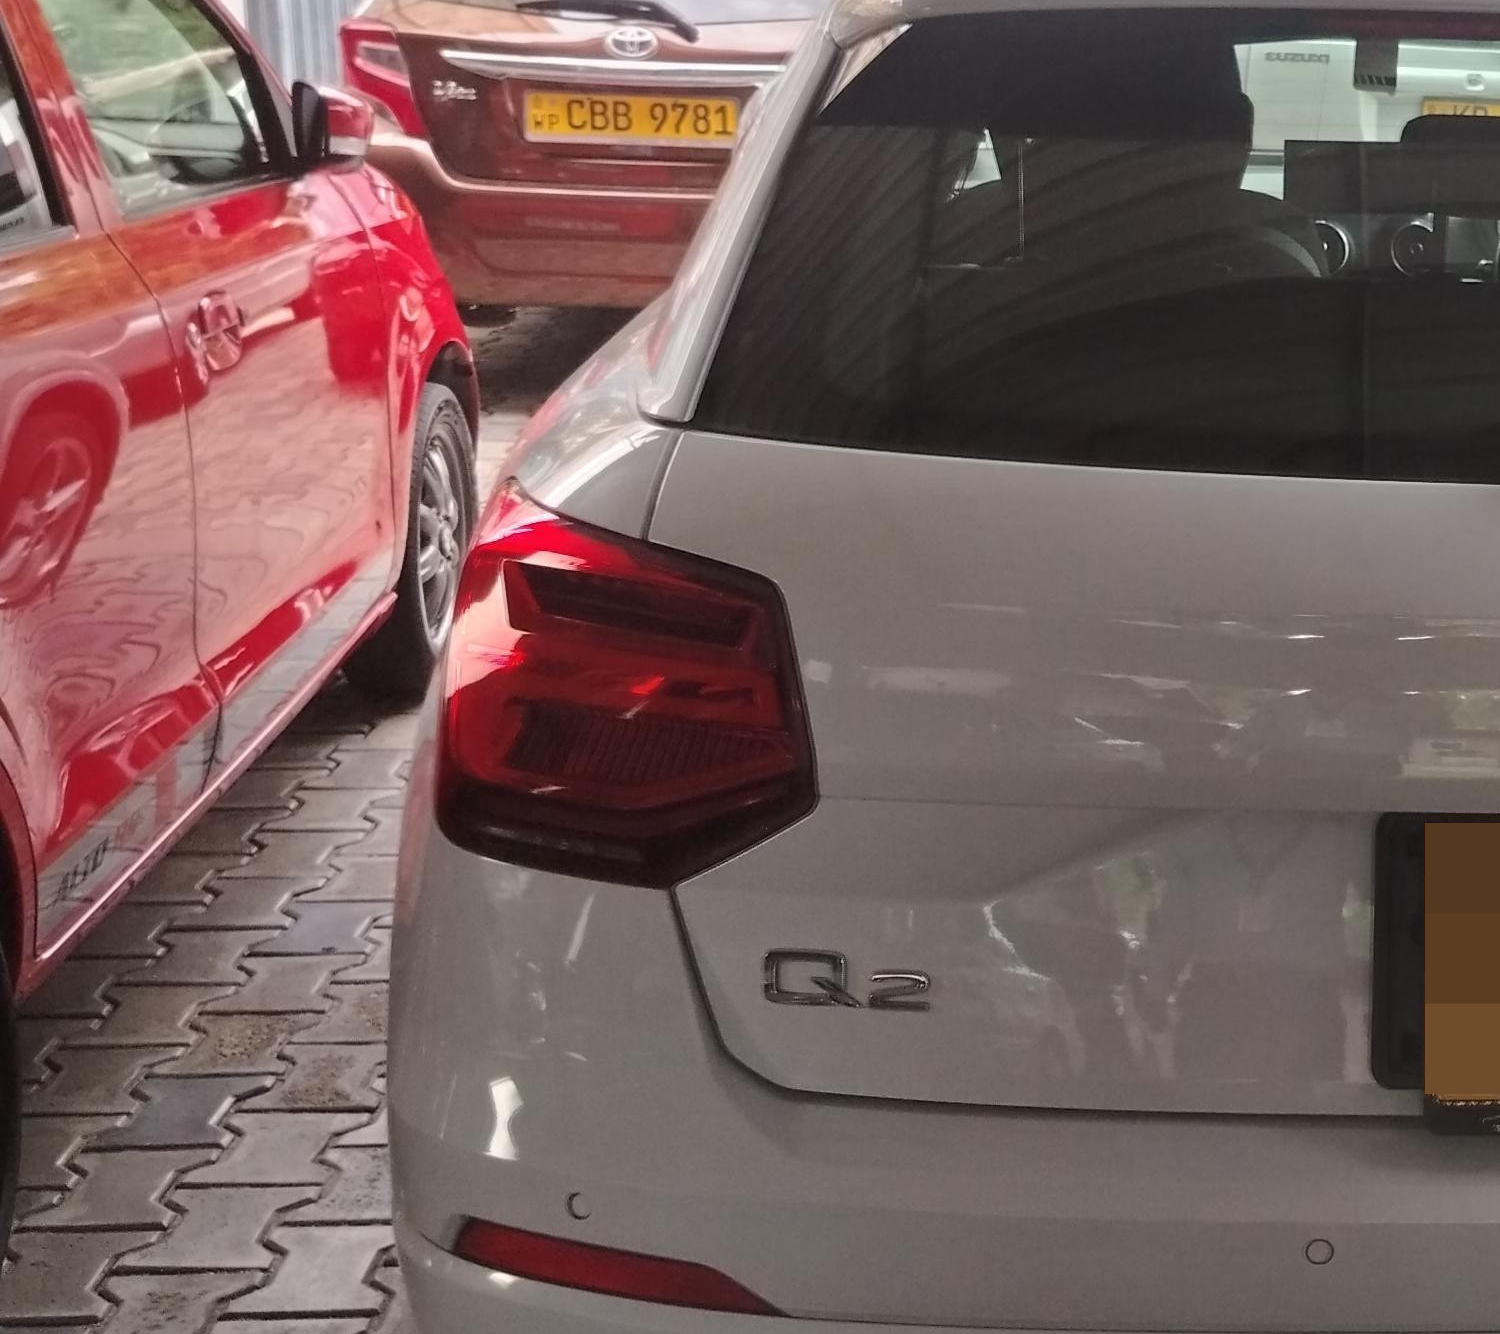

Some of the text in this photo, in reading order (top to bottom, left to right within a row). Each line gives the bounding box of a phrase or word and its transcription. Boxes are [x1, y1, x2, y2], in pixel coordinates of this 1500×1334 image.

[534, 98, 733, 136] WP CBB 9781
[763, 948, 931, 1012] Q2
